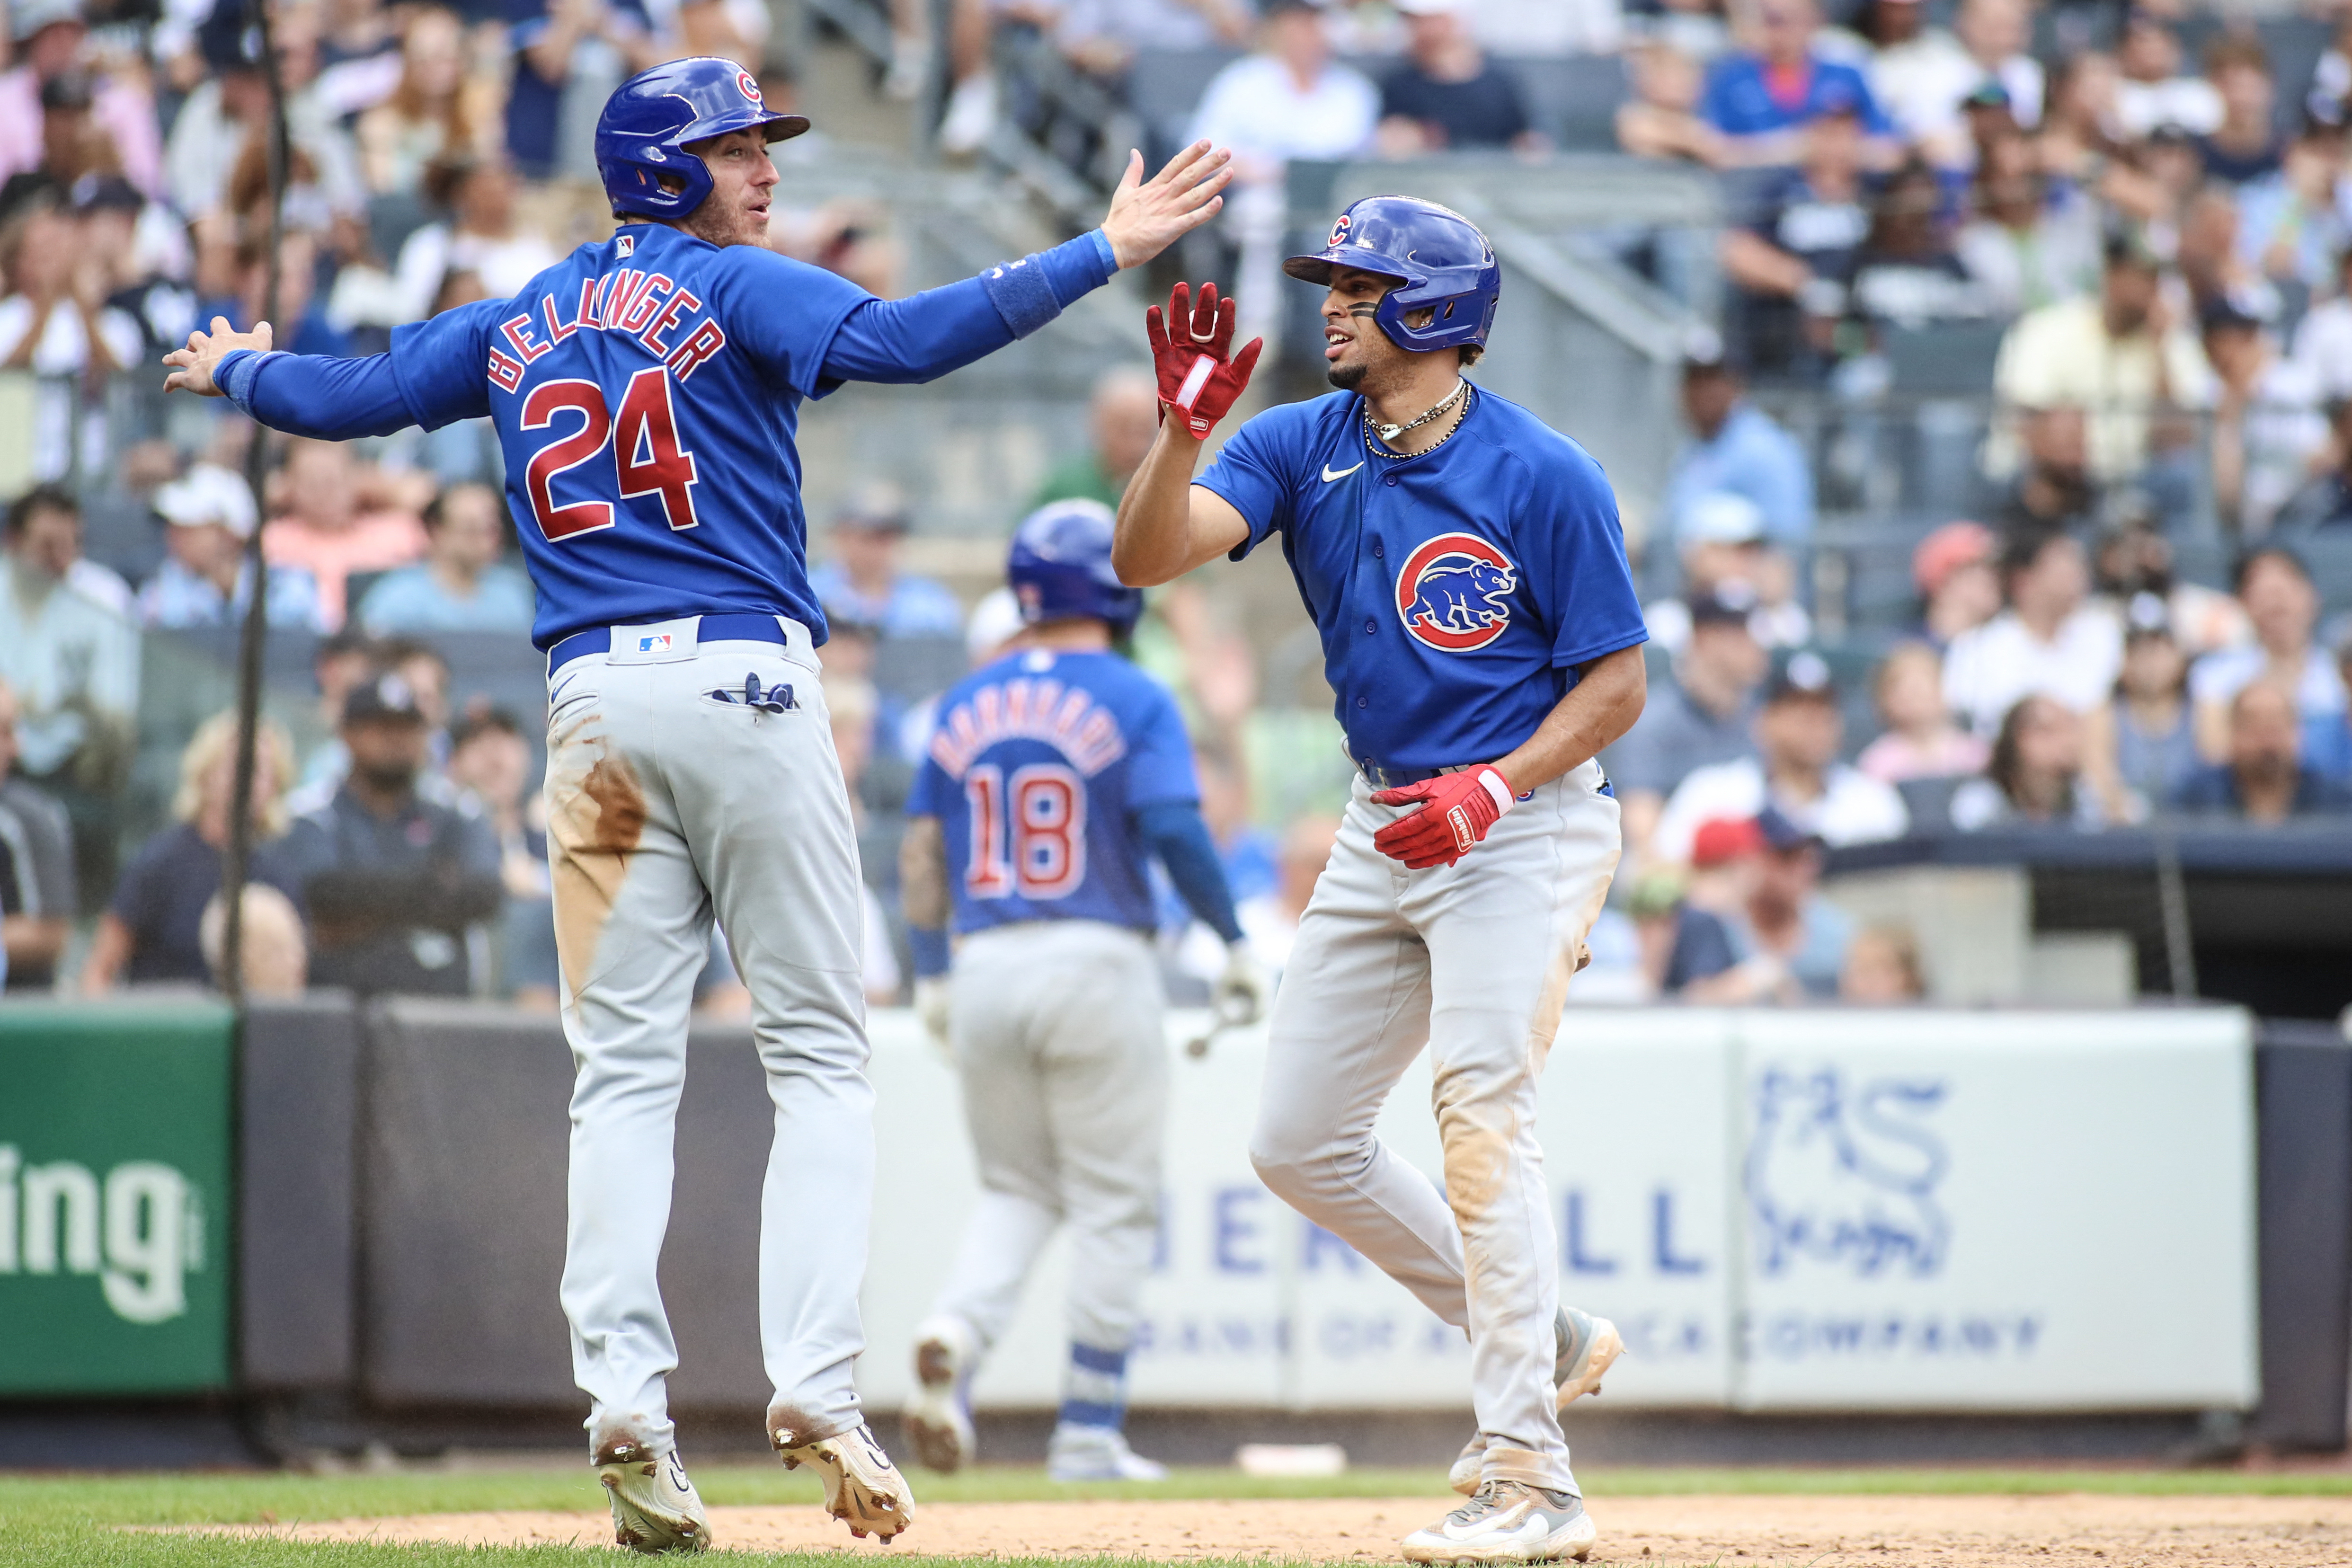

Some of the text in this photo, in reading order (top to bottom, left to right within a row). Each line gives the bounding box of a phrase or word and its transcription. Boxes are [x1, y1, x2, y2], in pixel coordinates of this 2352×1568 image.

[735, 70, 762, 103] C
[1327, 214, 1351, 248] C
[487, 268, 726, 395] BELLINGER
[520, 364, 698, 543] 24
[963, 762, 1088, 901] 18
